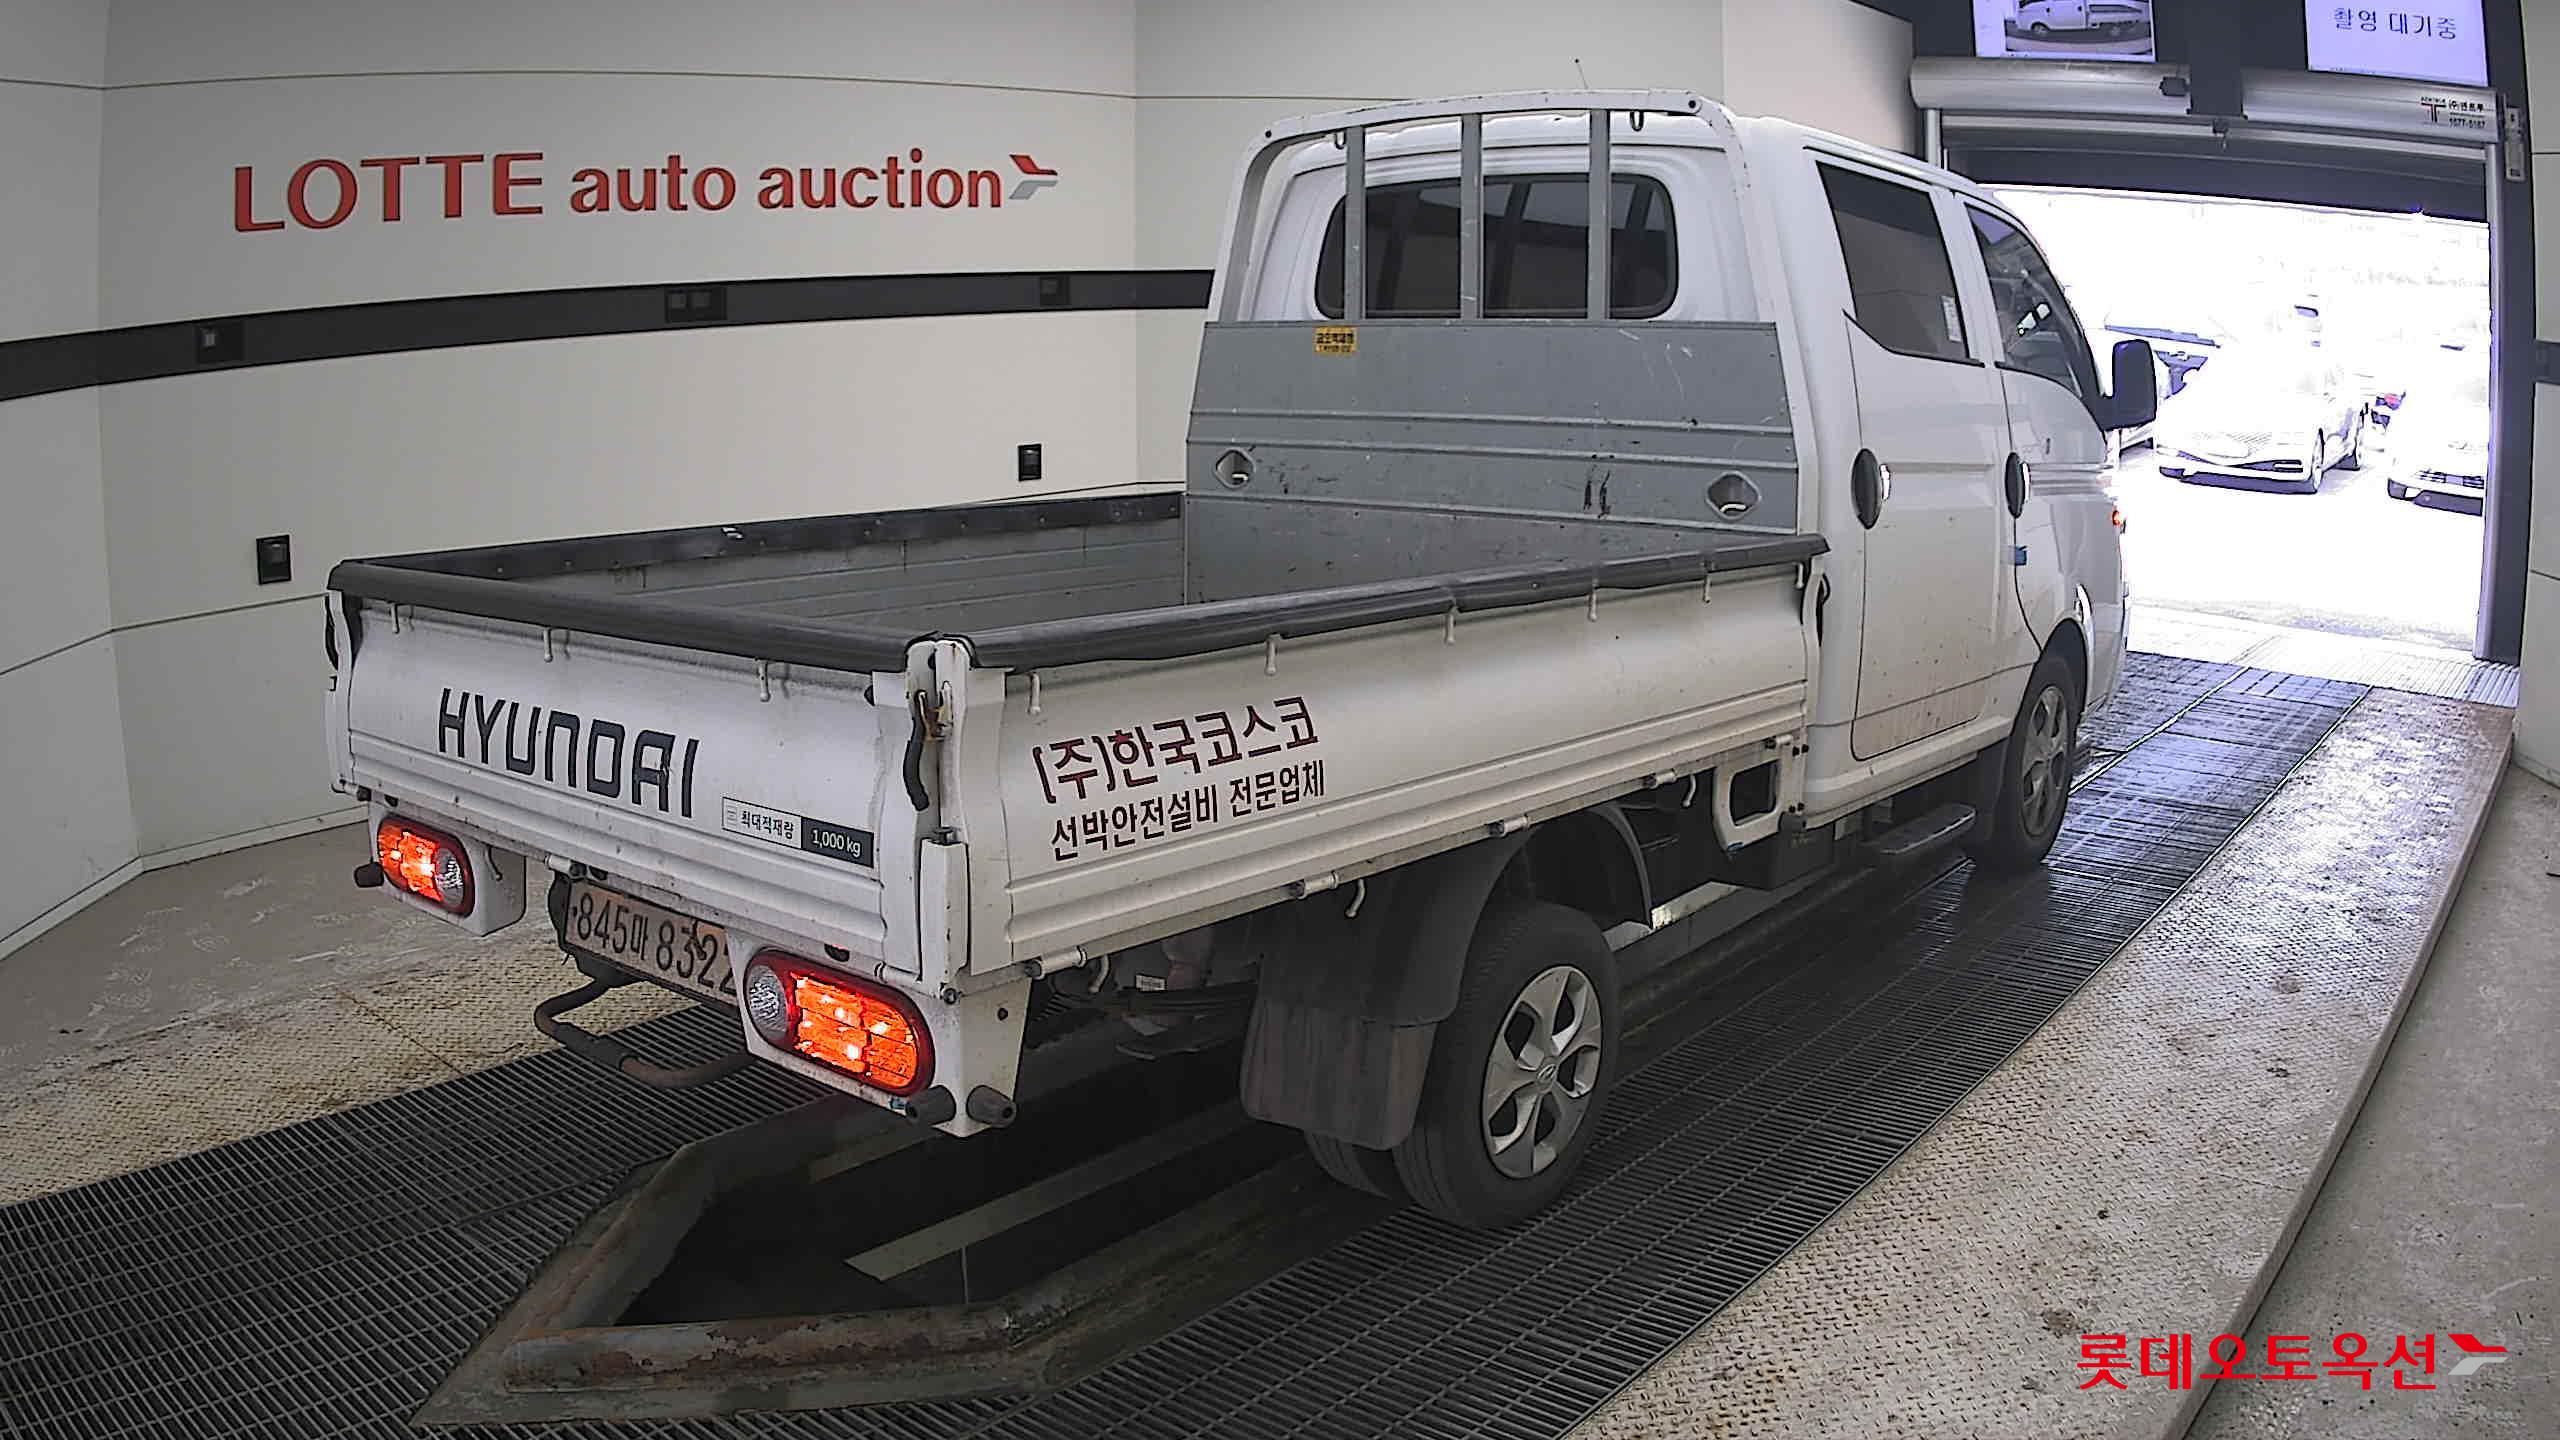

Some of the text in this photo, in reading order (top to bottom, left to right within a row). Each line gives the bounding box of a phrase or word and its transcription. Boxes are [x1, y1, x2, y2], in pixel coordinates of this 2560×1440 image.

[2334, 7, 2457, 40] 촬영 대기중
[234, 147, 1003, 233] LOTTE auto auction
[438, 687, 701, 819] HYUNDAI
[1031, 696, 1319, 804] (주)한국코스코
[741, 810, 794, 840] 최대적재량
[811, 829, 845, 850] 1,000
[846, 837, 862, 858] kg
[1050, 758, 1326, 862] 선박안전설비 전문업체
[577, 892, 649, 961] 845마
